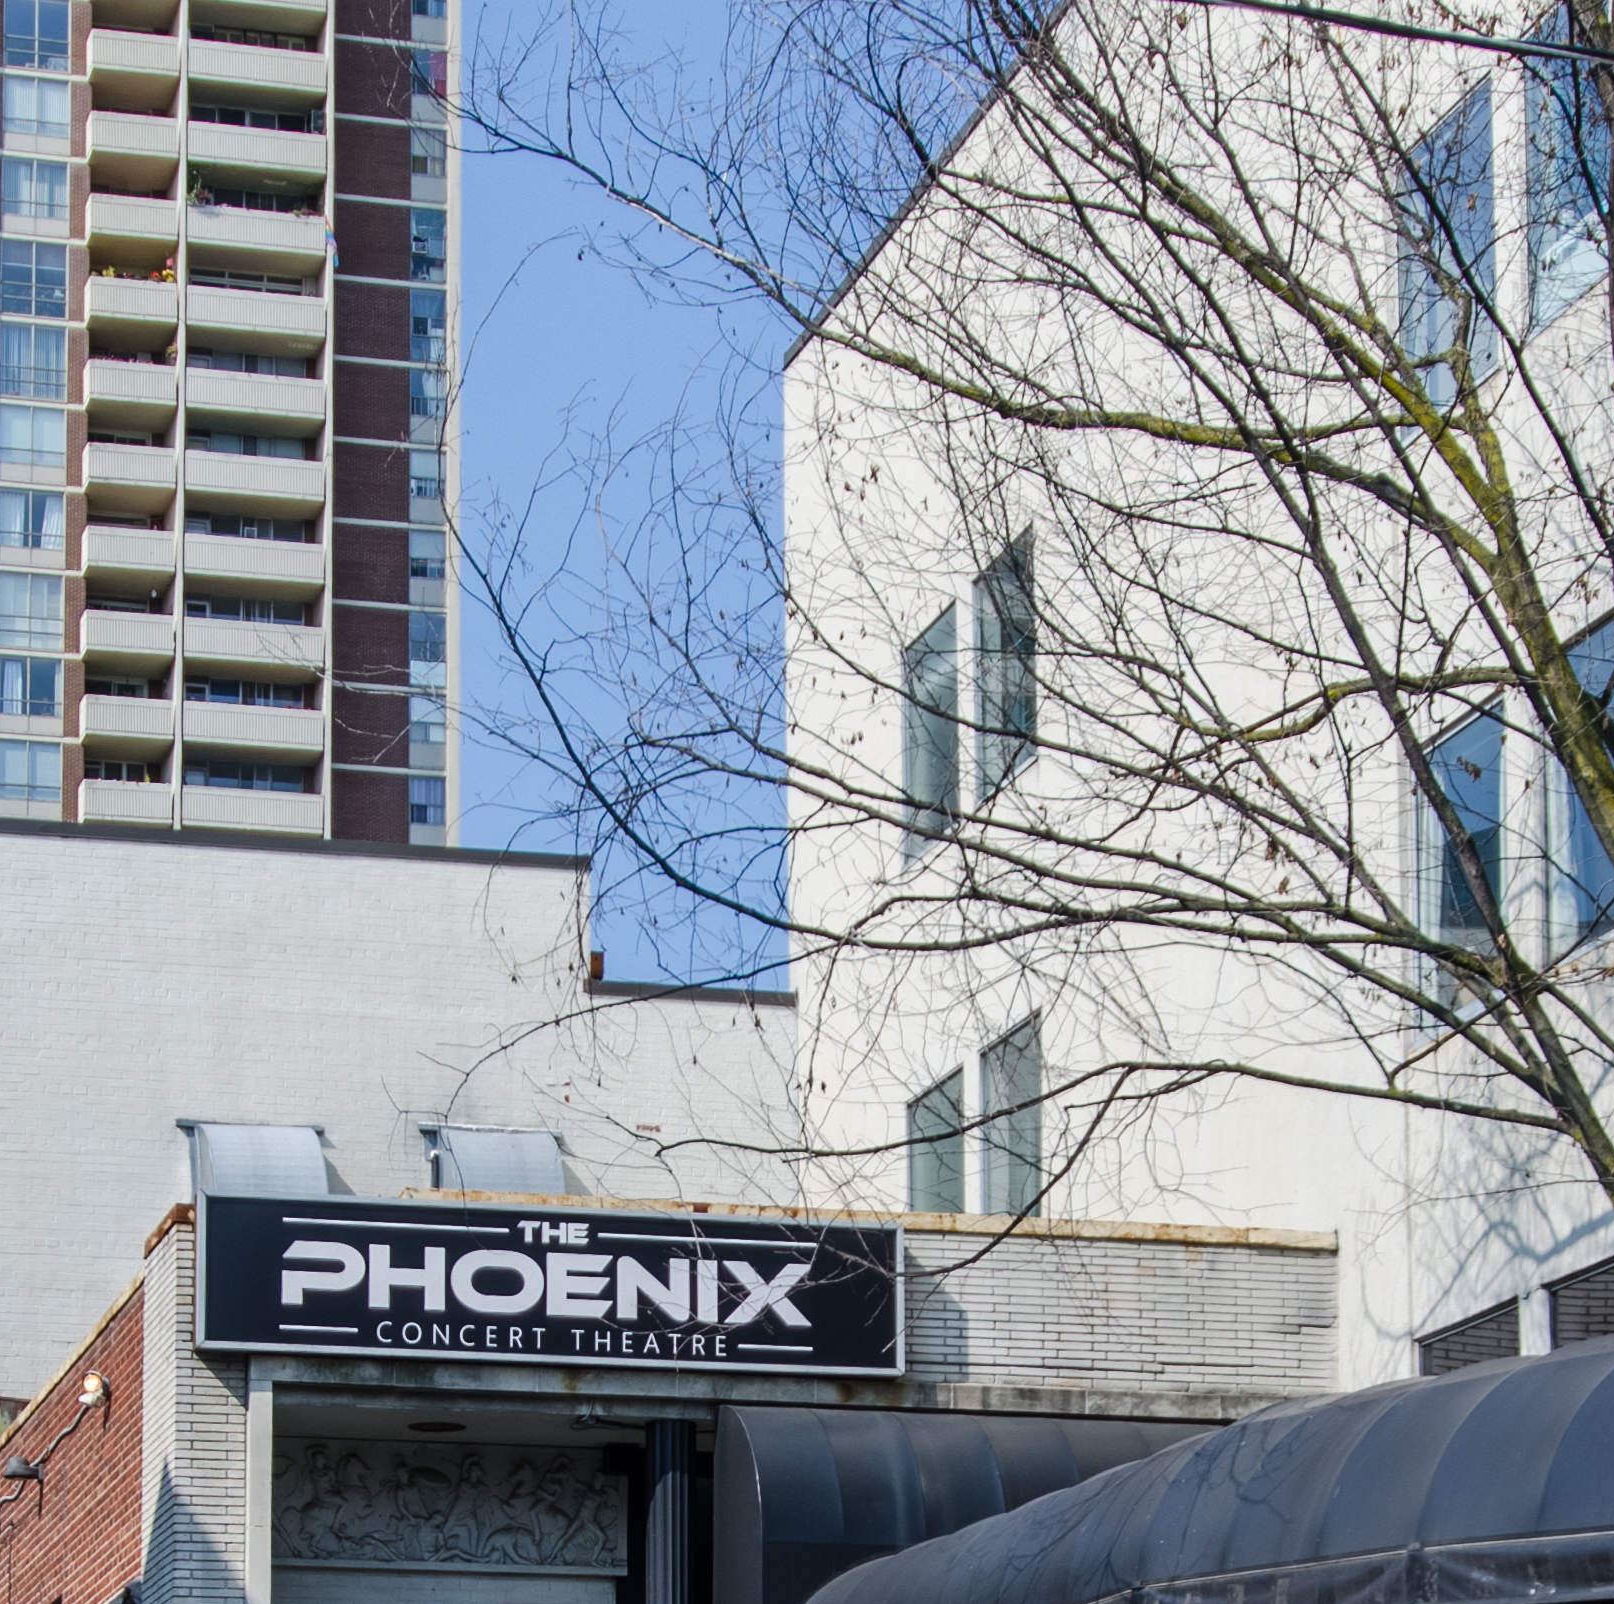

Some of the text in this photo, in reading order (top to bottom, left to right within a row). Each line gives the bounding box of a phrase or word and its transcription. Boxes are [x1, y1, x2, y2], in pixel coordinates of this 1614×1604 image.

[516, 1219, 590, 1246] THE
[281, 1239, 813, 1328] PHOENIX
[375, 1321, 728, 1357] CONCERT THEATRE
